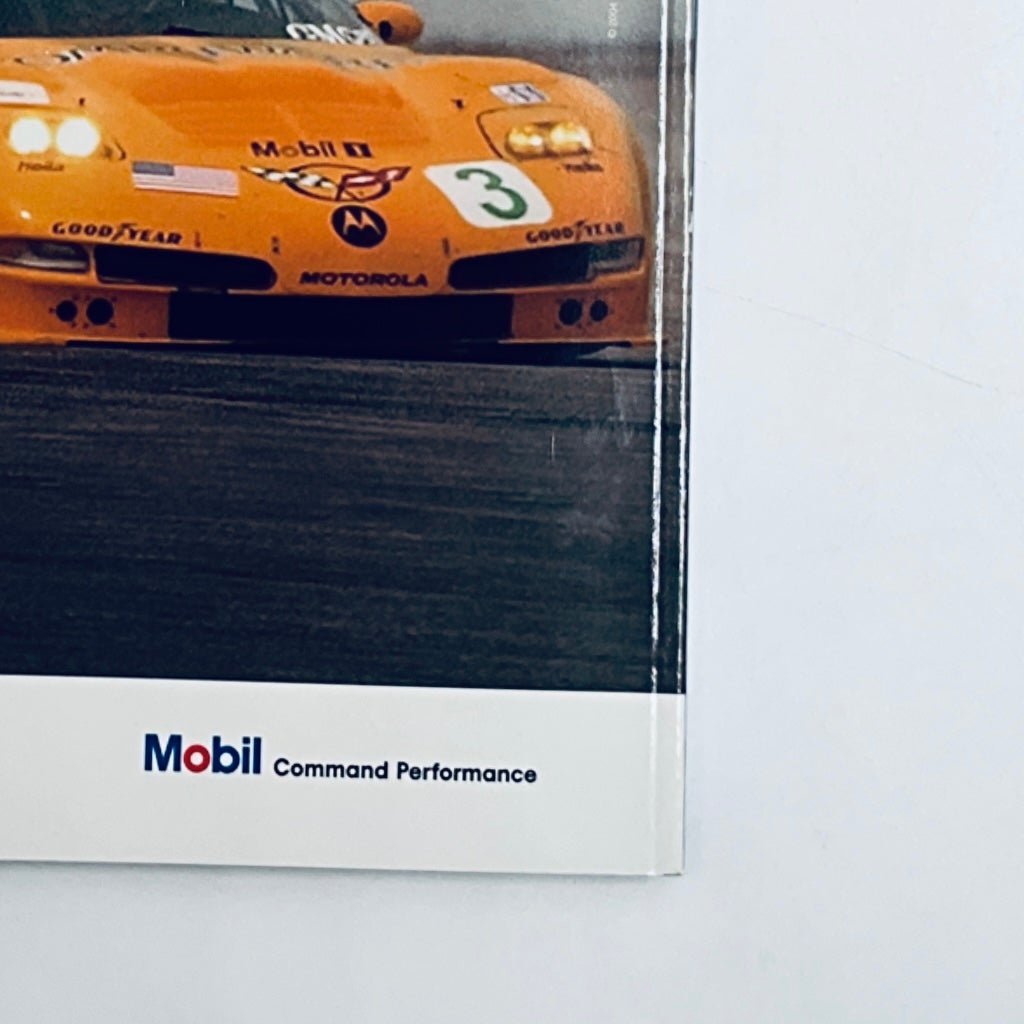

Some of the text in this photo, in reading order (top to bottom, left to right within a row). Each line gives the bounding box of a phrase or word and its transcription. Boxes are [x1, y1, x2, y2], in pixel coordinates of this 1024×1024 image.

[251, 141, 337, 158] Mobil
[455, 167, 528, 220] 3
[299, 271, 428, 287] MOTOROLA
[144, 733, 537, 783] Mobil Command Performance
